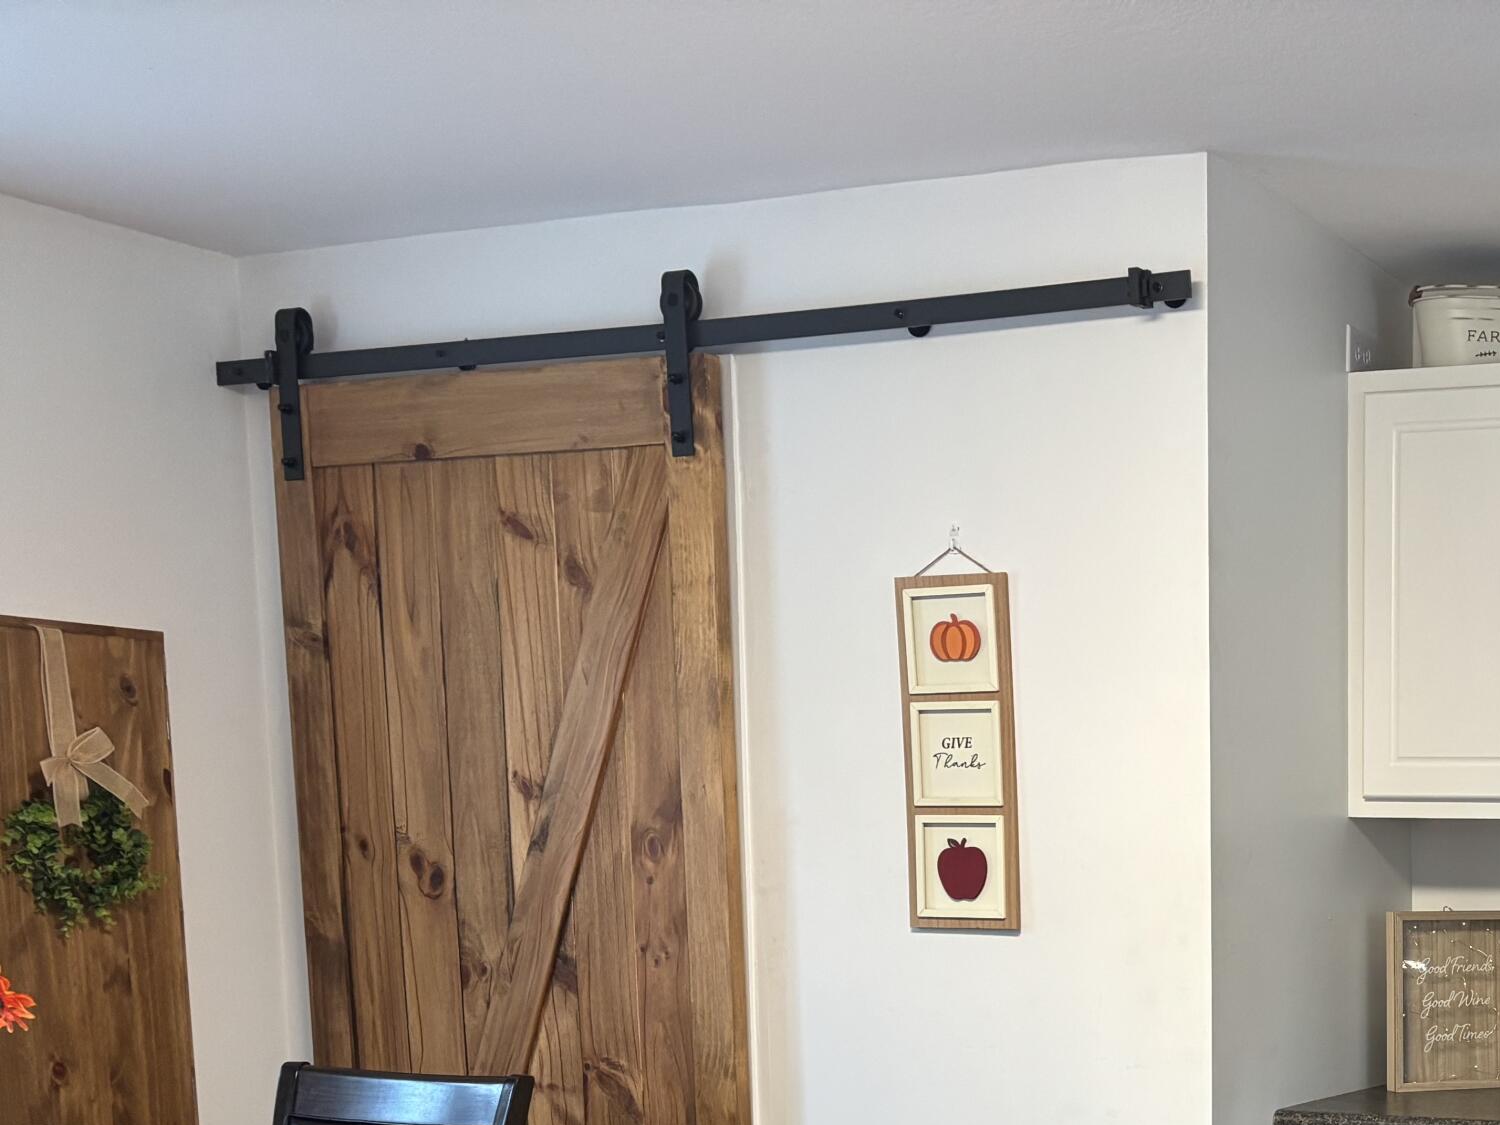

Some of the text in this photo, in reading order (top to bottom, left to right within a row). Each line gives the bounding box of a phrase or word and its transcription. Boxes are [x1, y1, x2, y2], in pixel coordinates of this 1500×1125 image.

[941, 736, 973, 749] GIVE
[932, 752, 986, 770] Thanks
[1416, 956, 1450, 985] Good
[1420, 989, 1491, 1019] Good Wine
[1424, 1024, 1457, 1053] Good
